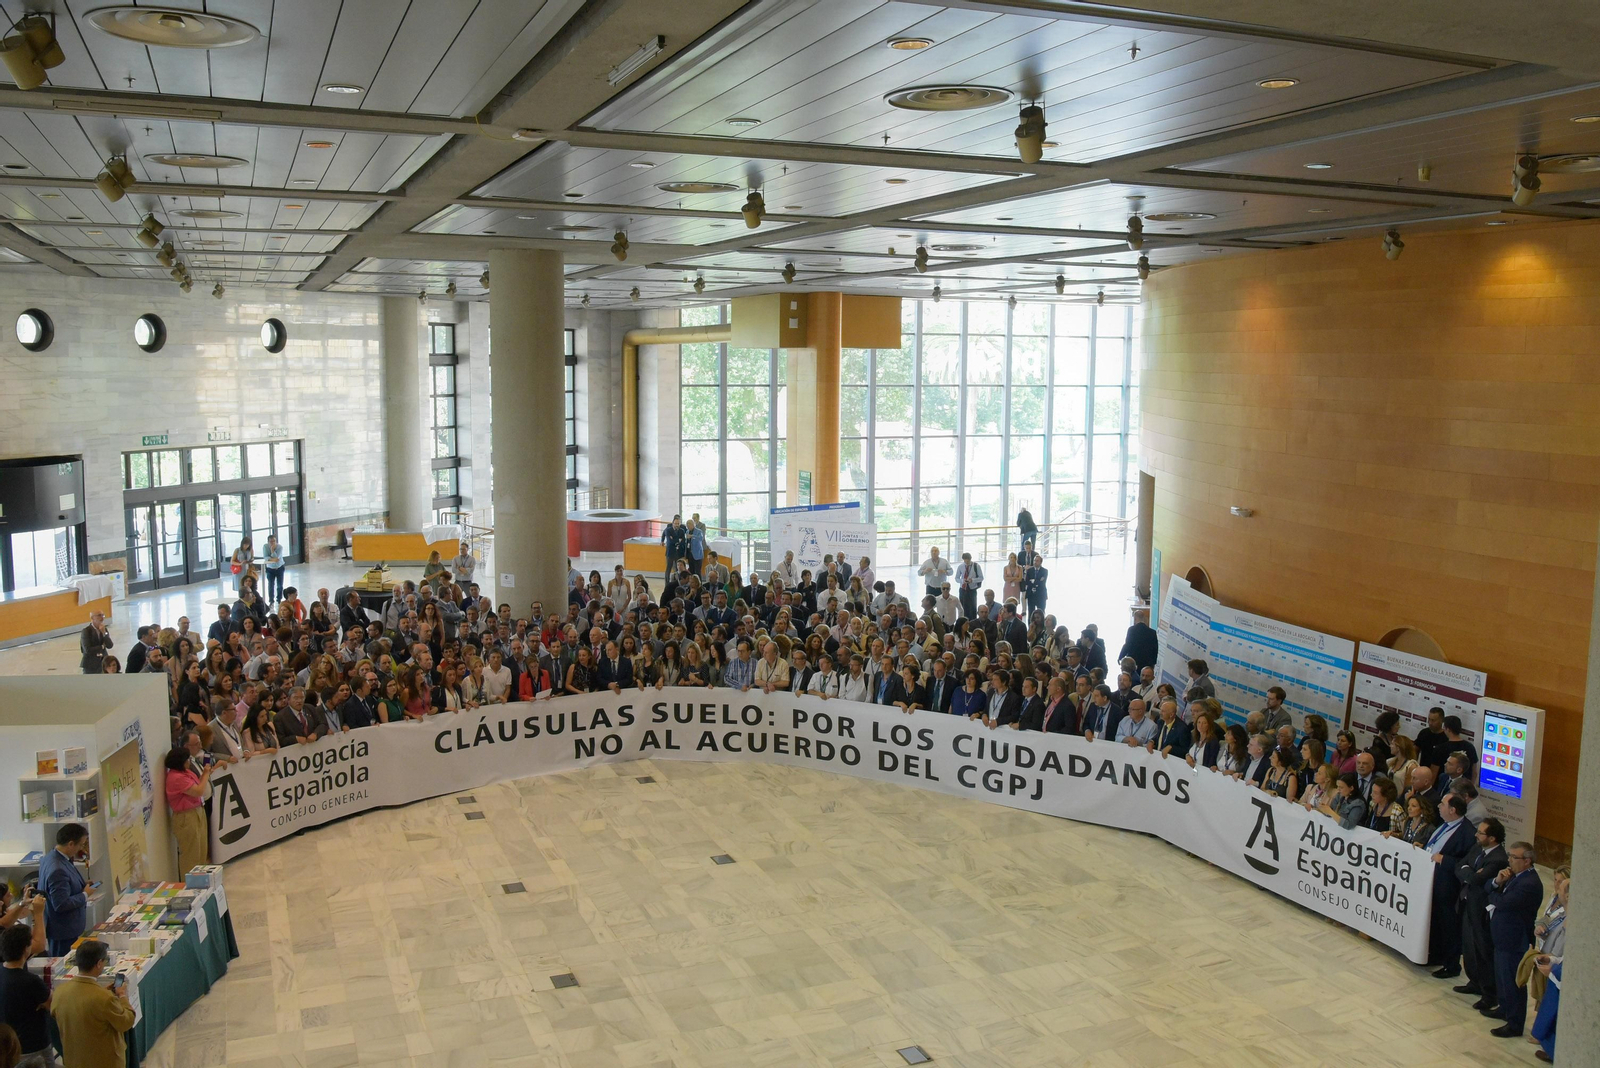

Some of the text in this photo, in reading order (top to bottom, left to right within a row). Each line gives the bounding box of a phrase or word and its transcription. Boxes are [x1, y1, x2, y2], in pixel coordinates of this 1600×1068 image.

[825, 530, 842, 542] VII
[1387, 656, 1404, 664] BUENAS
[1405, 660, 1430, 671] PRÁCTICAS
[1446, 670, 1470, 681] ABOGACÍA
[266, 739, 369, 783] Abogacía
[434, 702, 1191, 804] CLÁUSULAS SUELO: POR LOS CIUDADANOS
[574, 729, 1044, 801] NO AL ACUERDO DEL CGPJ
[267, 764, 369, 811] Española
[270, 789, 369, 829] CONSEJO GENERAL
[1300, 820, 1412, 884] Abogacía
[1297, 848, 1409, 916] Española
[1297, 880, 1405, 938] CONSEJO GENERAL
